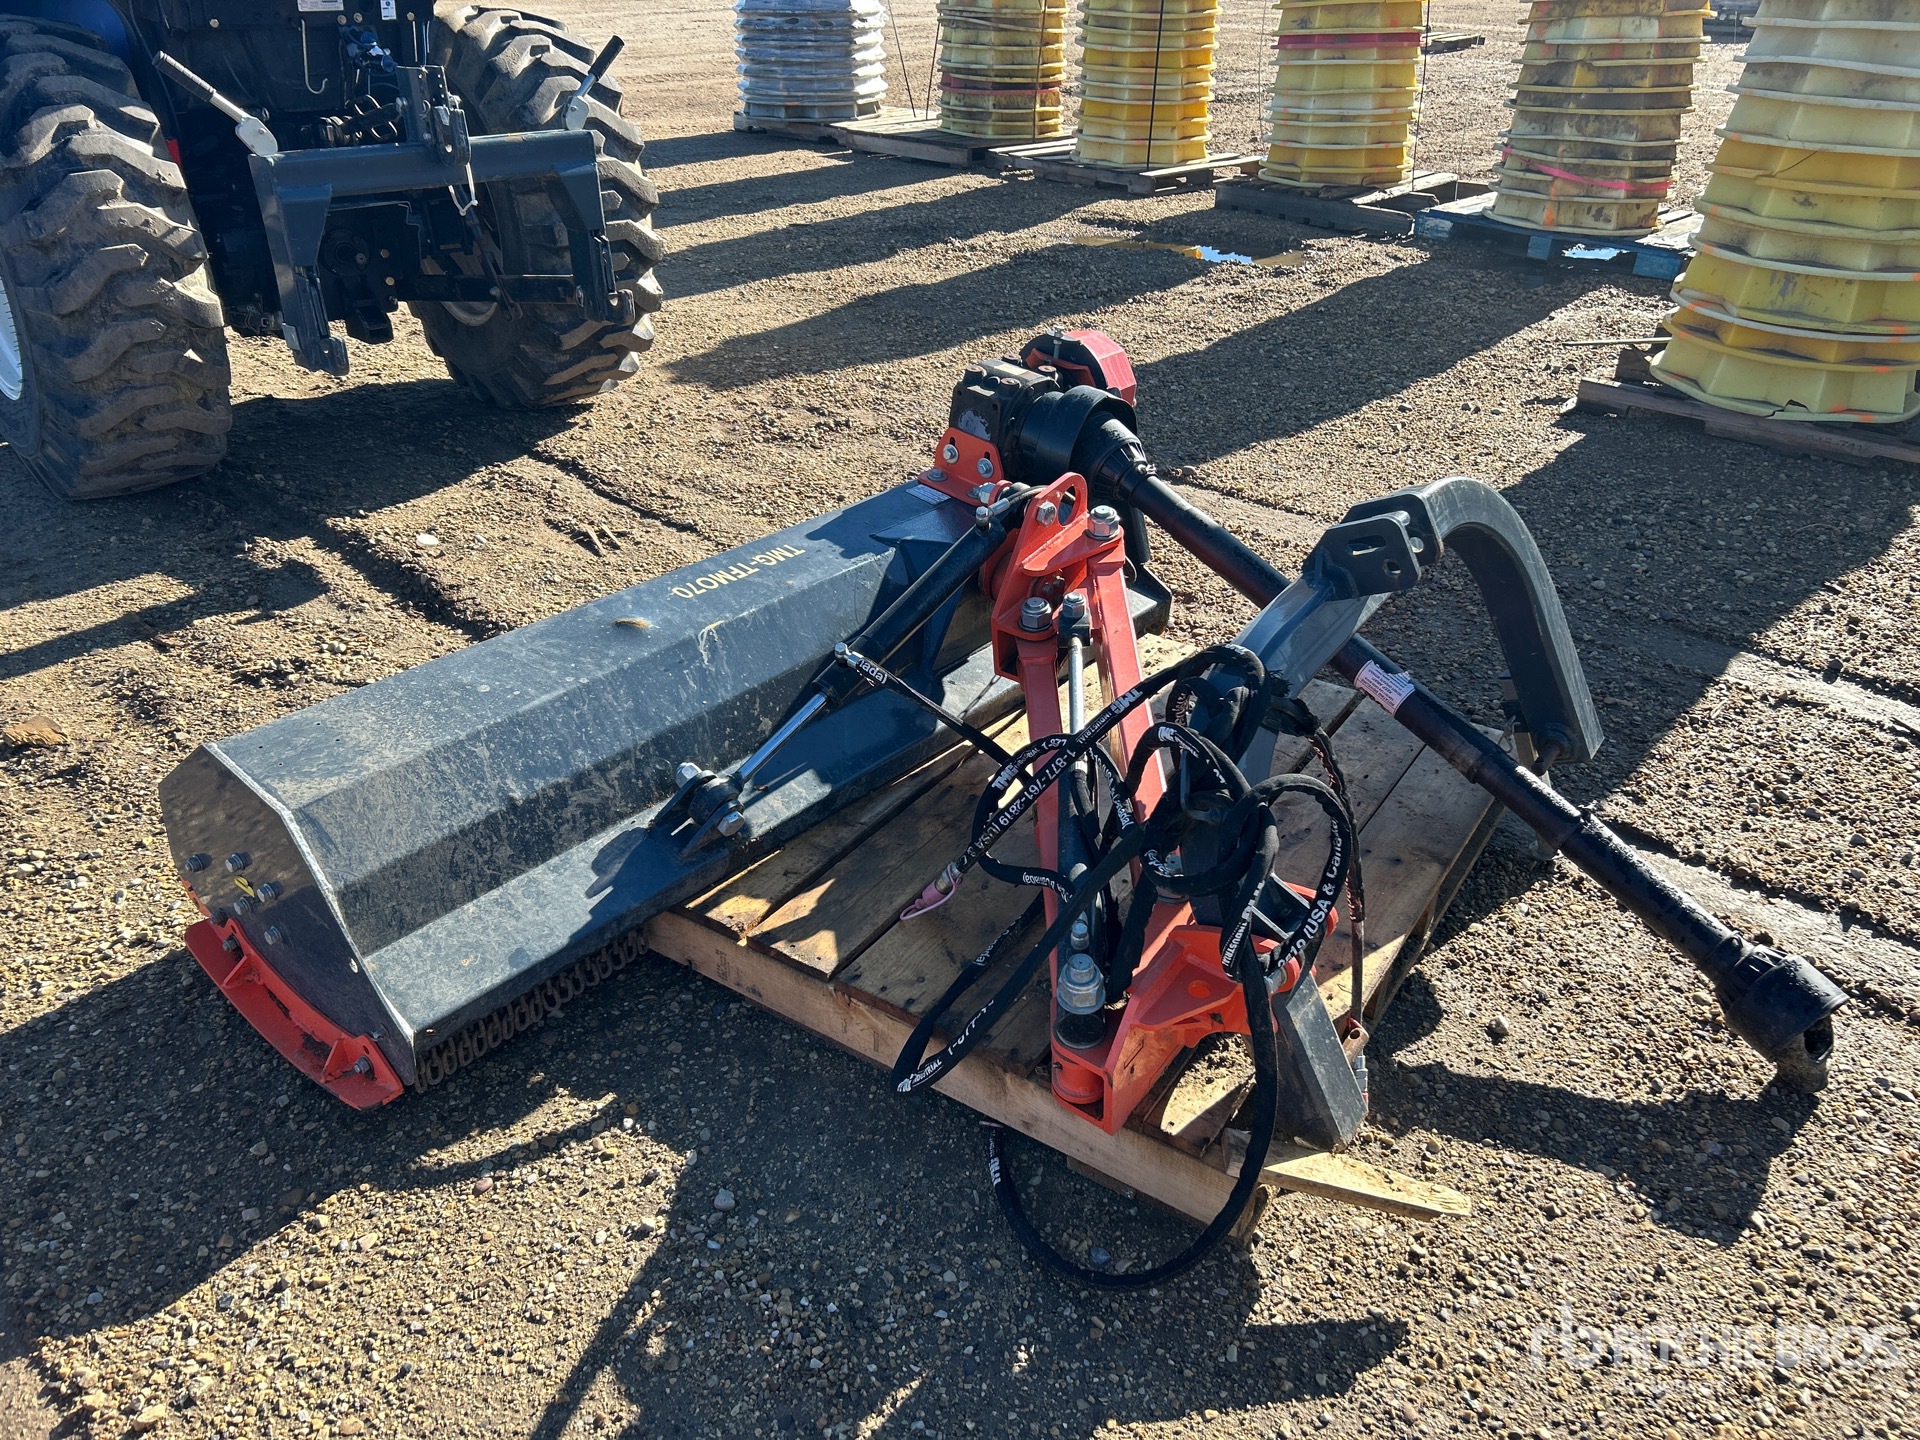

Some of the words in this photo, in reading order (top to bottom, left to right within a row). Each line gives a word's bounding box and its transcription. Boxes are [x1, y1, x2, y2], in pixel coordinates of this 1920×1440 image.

[1110, 688, 1143, 714] TMG
[1076, 711, 1112, 744] INDUSTRIAL
[991, 762, 1019, 791] TMG
[998, 748, 1077, 826] 1-877-761-2819
[1303, 899, 1331, 939] (USA
[1322, 883, 1335, 896] &
